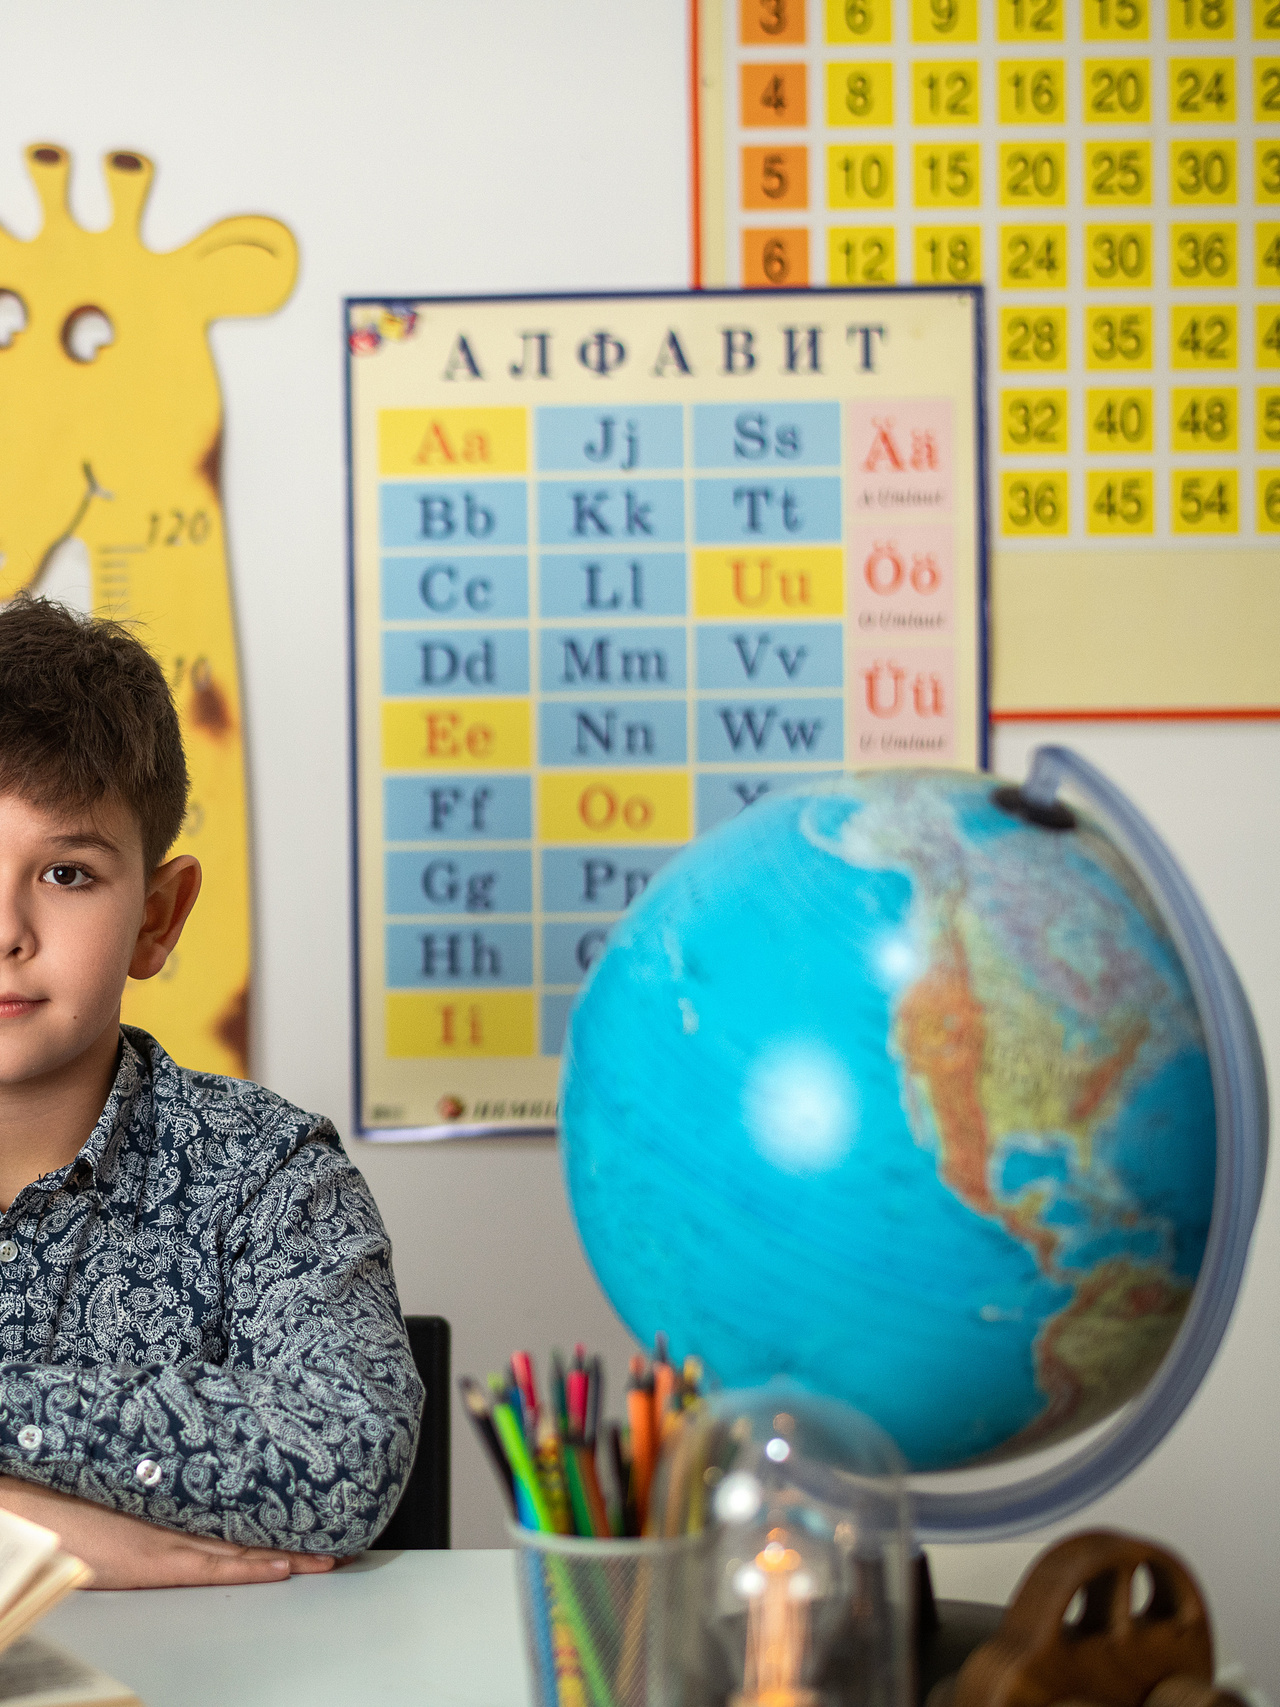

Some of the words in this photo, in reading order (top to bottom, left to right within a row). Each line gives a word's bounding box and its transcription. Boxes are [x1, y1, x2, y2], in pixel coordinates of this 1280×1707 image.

[845, 0, 873, 34] 6
[930, 0, 960, 33] 9
[1011, 0, 1057, 32] 12
[1181, 0, 1227, 30] 18
[760, 74, 787, 115] 4
[845, 72, 874, 117] 8
[921, 71, 973, 116] 12
[1007, 70, 1059, 115] 16
[1090, 68, 1144, 114] 20
[1176, 68, 1228, 113] 24
[761, 154, 790, 200] 5
[838, 155, 889, 199] 10
[923, 153, 974, 198] 15
[1006, 152, 1059, 197] 20
[1091, 151, 1144, 196] 25
[1177, 150, 1230, 195] 30
[762, 238, 789, 282] 6
[839, 238, 888, 281] 12
[924, 236, 974, 280] 18
[1007, 234, 1059, 279] 24
[1092, 233, 1145, 278] 30
[1177, 232, 1230, 278] 36
[444, 323, 888, 381] АЛФАВИТ
[1006, 317, 1059, 362] 28
[1092, 316, 1144, 361] 35
[1177, 315, 1230, 360] 42
[414, 420, 493, 467] Aa
[584, 417, 641, 471] Jj
[732, 413, 803, 459] Ss
[861, 415, 939, 473] Ää
[1007, 399, 1059, 444] 32
[1092, 398, 1145, 444] 40
[1177, 397, 1230, 443] 48
[418, 492, 497, 540] Bb
[571, 490, 654, 537] Kk
[732, 486, 802, 535] Tt
[1007, 481, 1060, 527] 36
[1092, 480, 1145, 525] 45
[1179, 478, 1230, 525] 54
[147, 508, 213, 546] 120
[417, 565, 493, 612] Cc
[584, 561, 645, 611] Ll
[728, 558, 813, 607] Uu
[863, 539, 942, 596] Öö
[420, 639, 498, 687] Dd
[563, 636, 668, 684] Mm
[732, 632, 808, 680] Vv
[863, 659, 945, 718] Üü
[424, 712, 495, 758] Ee
[575, 710, 655, 755] Nn
[718, 707, 821, 751] Ww
[429, 786, 493, 833] Ff
[577, 785, 655, 830] Oo
[420, 861, 498, 912] Gg
[420, 935, 503, 979] Hh
[439, 1004, 485, 1049] Ii
